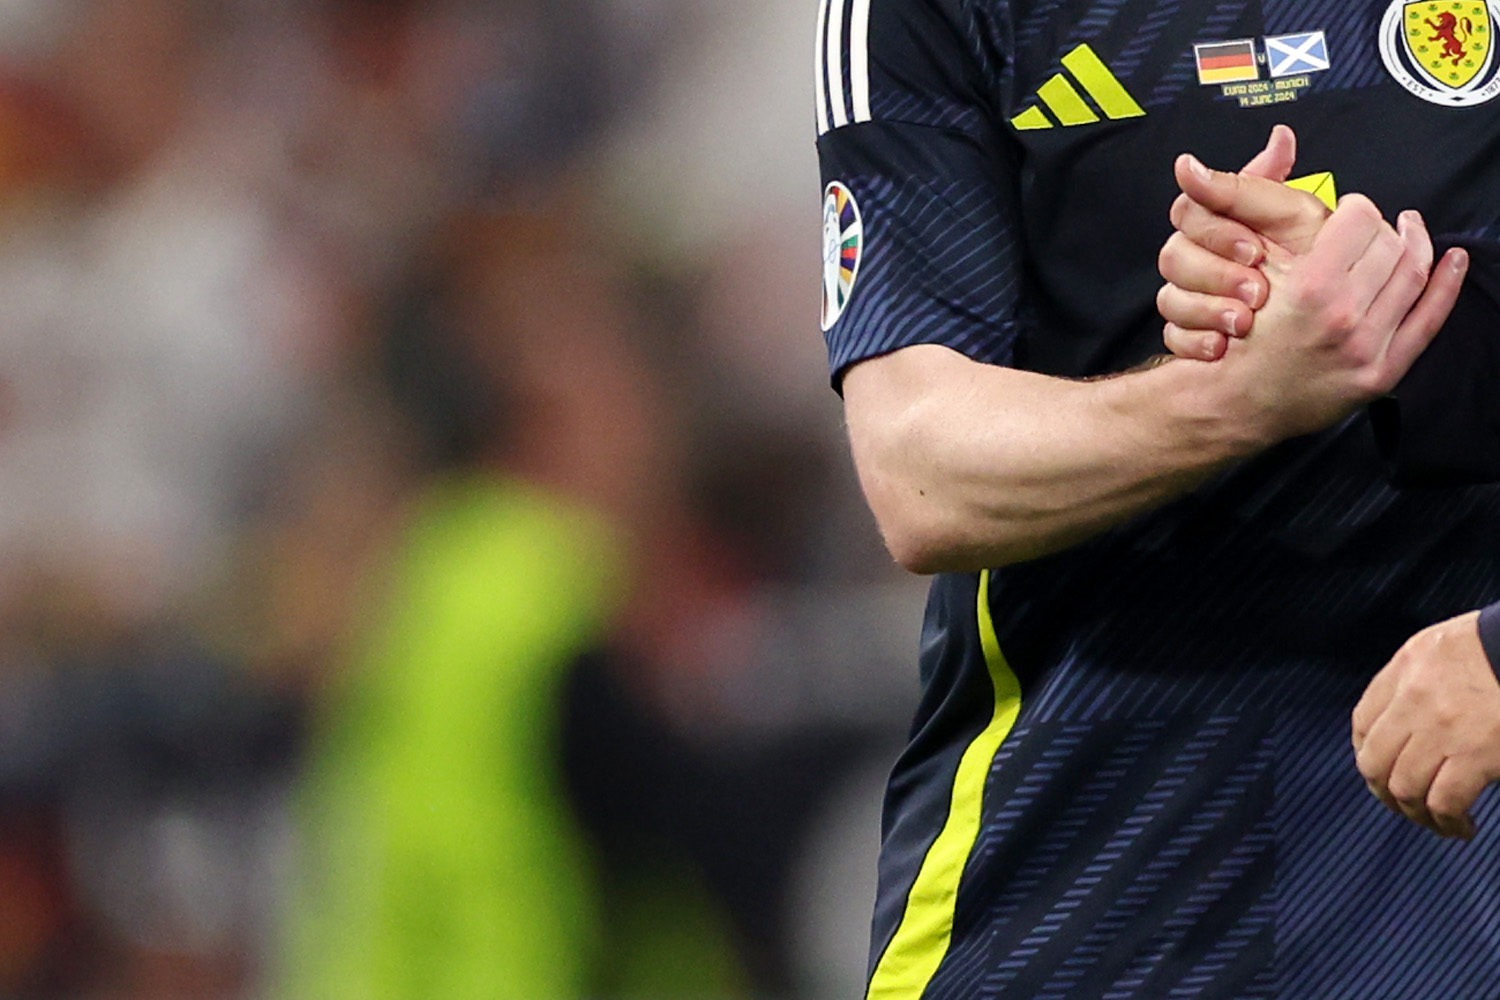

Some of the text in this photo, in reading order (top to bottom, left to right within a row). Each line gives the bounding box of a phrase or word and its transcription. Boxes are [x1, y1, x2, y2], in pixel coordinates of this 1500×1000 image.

[1248, 83, 1269, 94] 2024
[1250, 94, 1274, 105] JUNE
[1275, 91, 1295, 103] 2024
